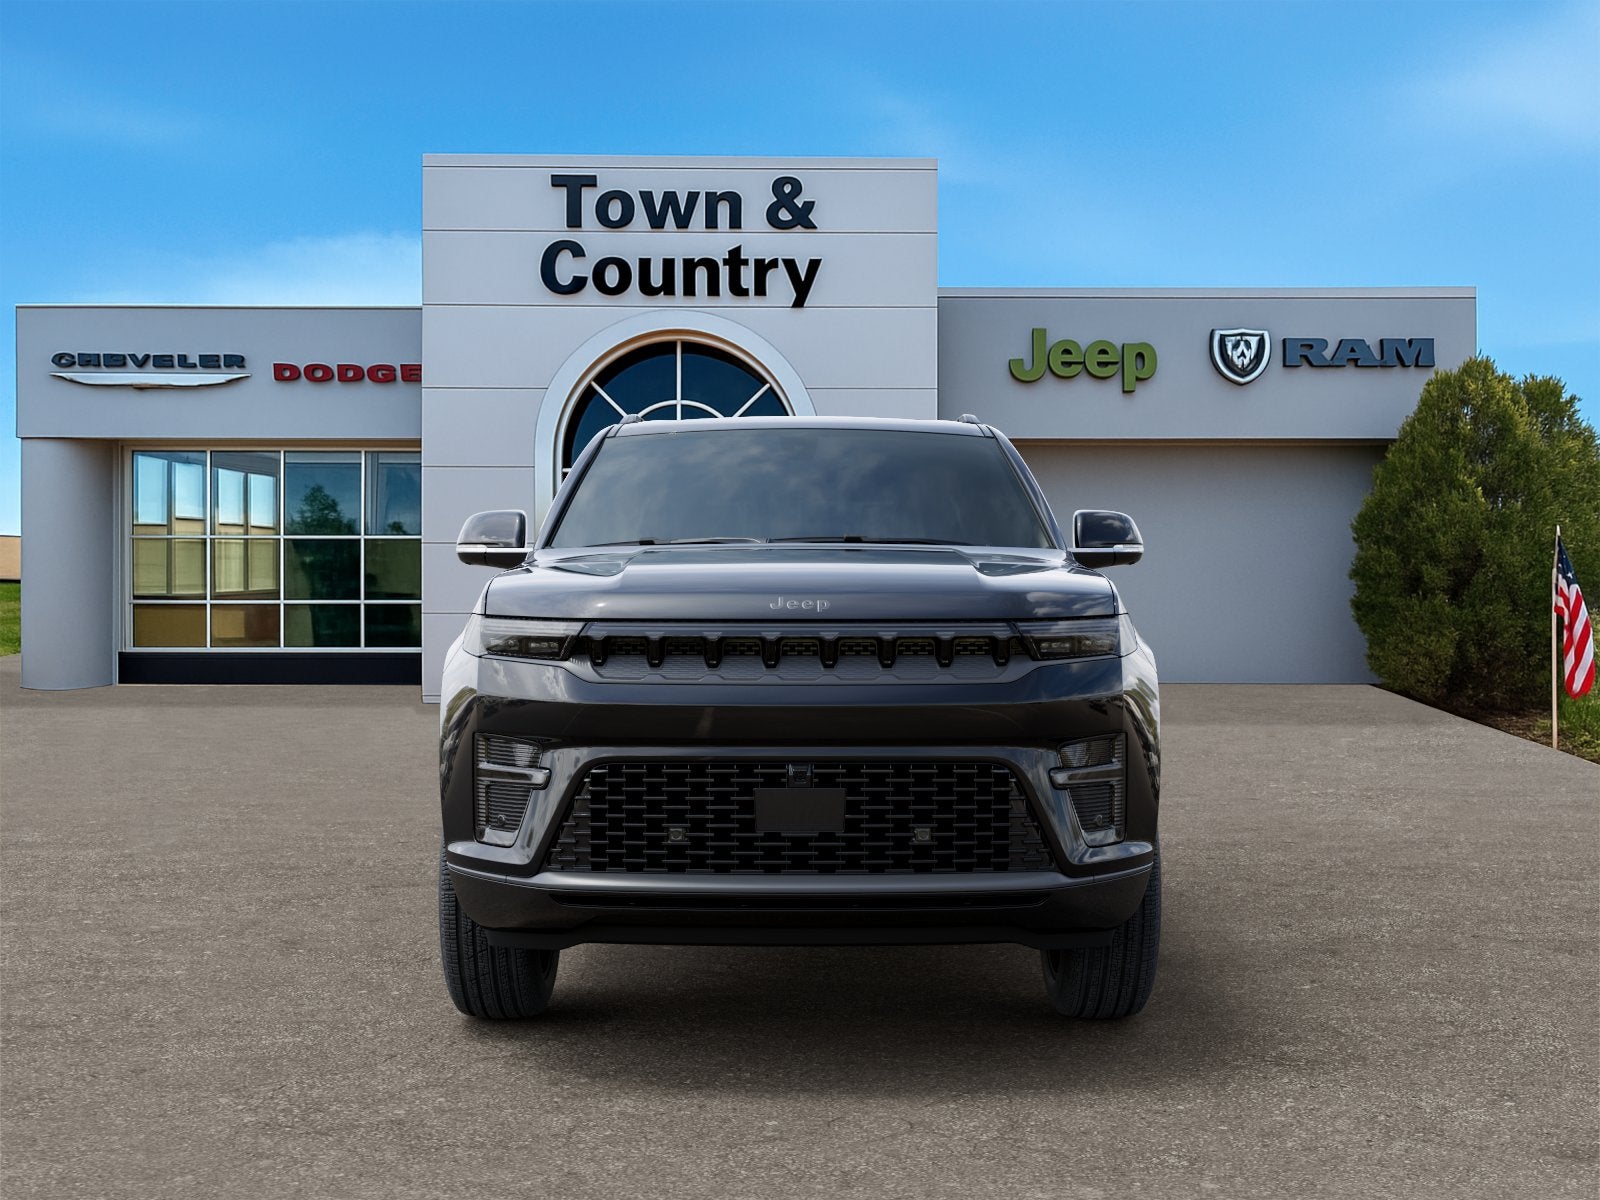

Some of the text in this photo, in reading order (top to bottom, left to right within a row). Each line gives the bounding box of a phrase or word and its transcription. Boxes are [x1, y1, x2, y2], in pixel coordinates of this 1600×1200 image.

[550, 174, 817, 230] Town &
[540, 240, 822, 308] Country
[273, 363, 422, 383] DODGE
[1009, 328, 1157, 393] Jeep
[1282, 338, 1436, 367] RAM
[769, 596, 831, 613] Jeep
